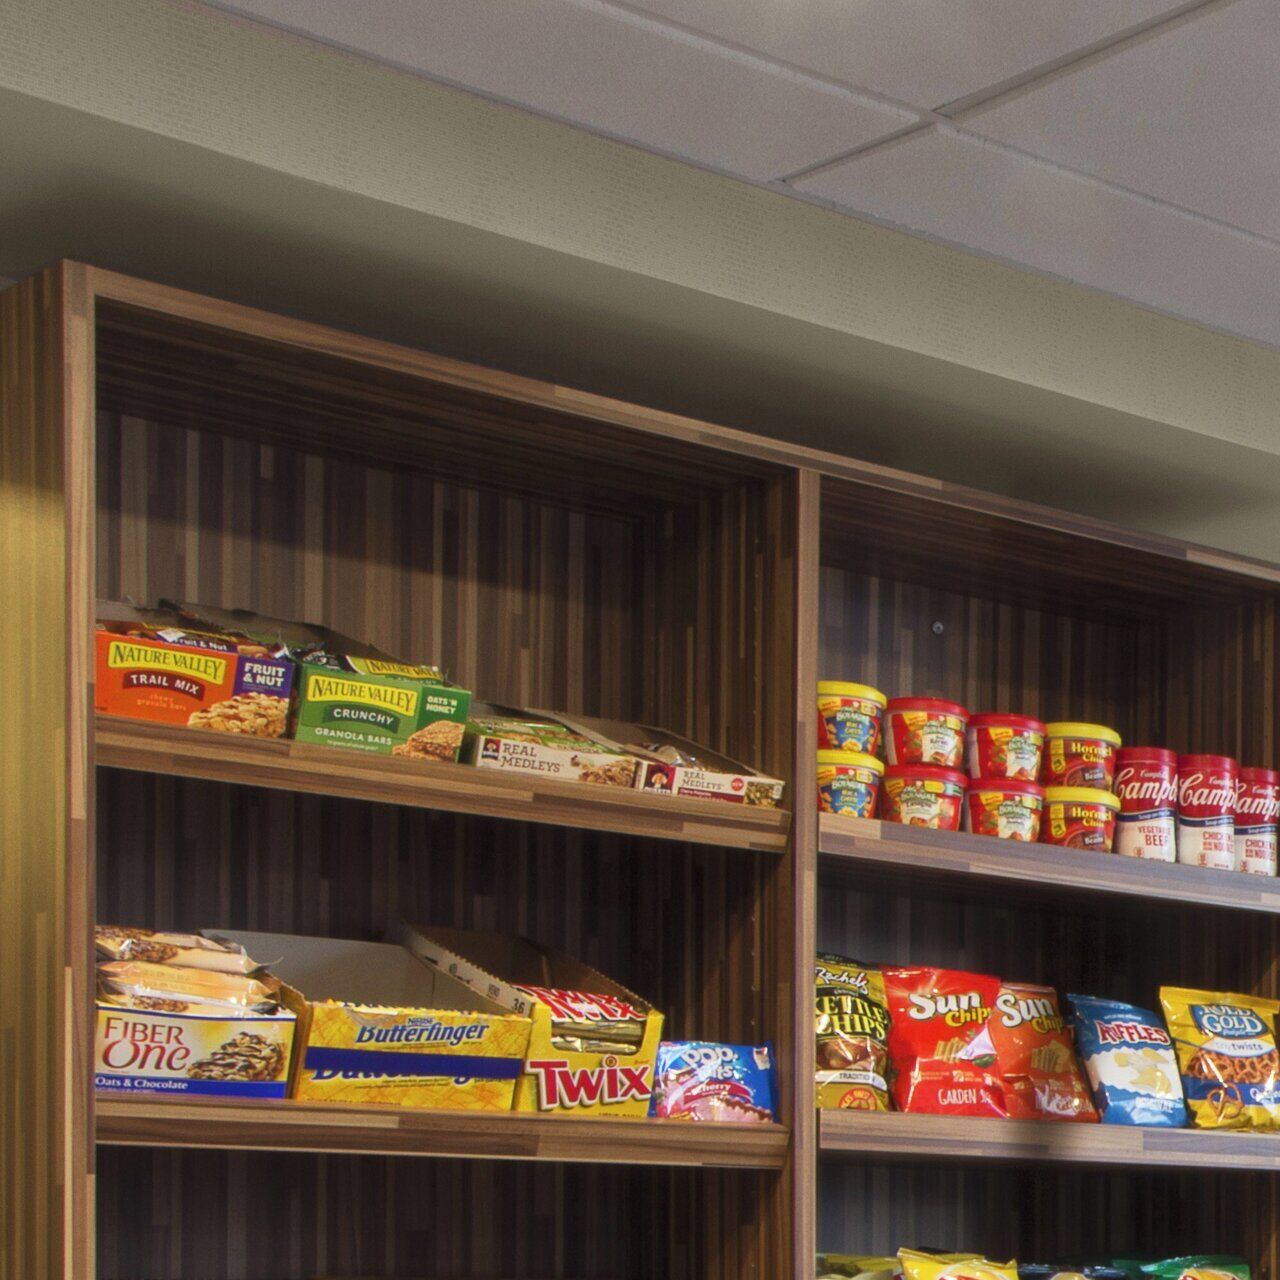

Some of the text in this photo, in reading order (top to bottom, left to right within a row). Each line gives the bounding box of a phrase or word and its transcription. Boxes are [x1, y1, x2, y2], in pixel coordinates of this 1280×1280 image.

[113, 643, 223, 681] NATURE VALLEY
[244, 662, 286, 678] FRUIT
[130, 674, 200, 695] TRAIL MIX
[244, 673, 285, 688] & NUT
[312, 678, 415, 713] NATURE VALLEY
[333, 708, 394, 725] CRUNCHY
[425, 703, 456, 715] HONEY
[315, 727, 393, 746] GRANOLA BARS
[502, 743, 538, 758] REAL
[1071, 742, 1112, 757] Hormel
[500, 756, 561, 774] MEDLEYS
[1072, 807, 1112, 821] Hormel
[908, 993, 982, 1020] Sun
[996, 993, 1054, 1027] Sun
[104, 1016, 183, 1046] FIBER
[1095, 1020, 1171, 1045] RUFFLES
[1202, 1013, 1263, 1034] GOLD
[355, 1022, 489, 1047] Butterfinger
[1231, 1041, 1264, 1051] twists
[101, 1040, 191, 1071] One
[95, 1076, 188, 1091] Oats & Chocolate
[938, 1088, 976, 1106] GARDEN
